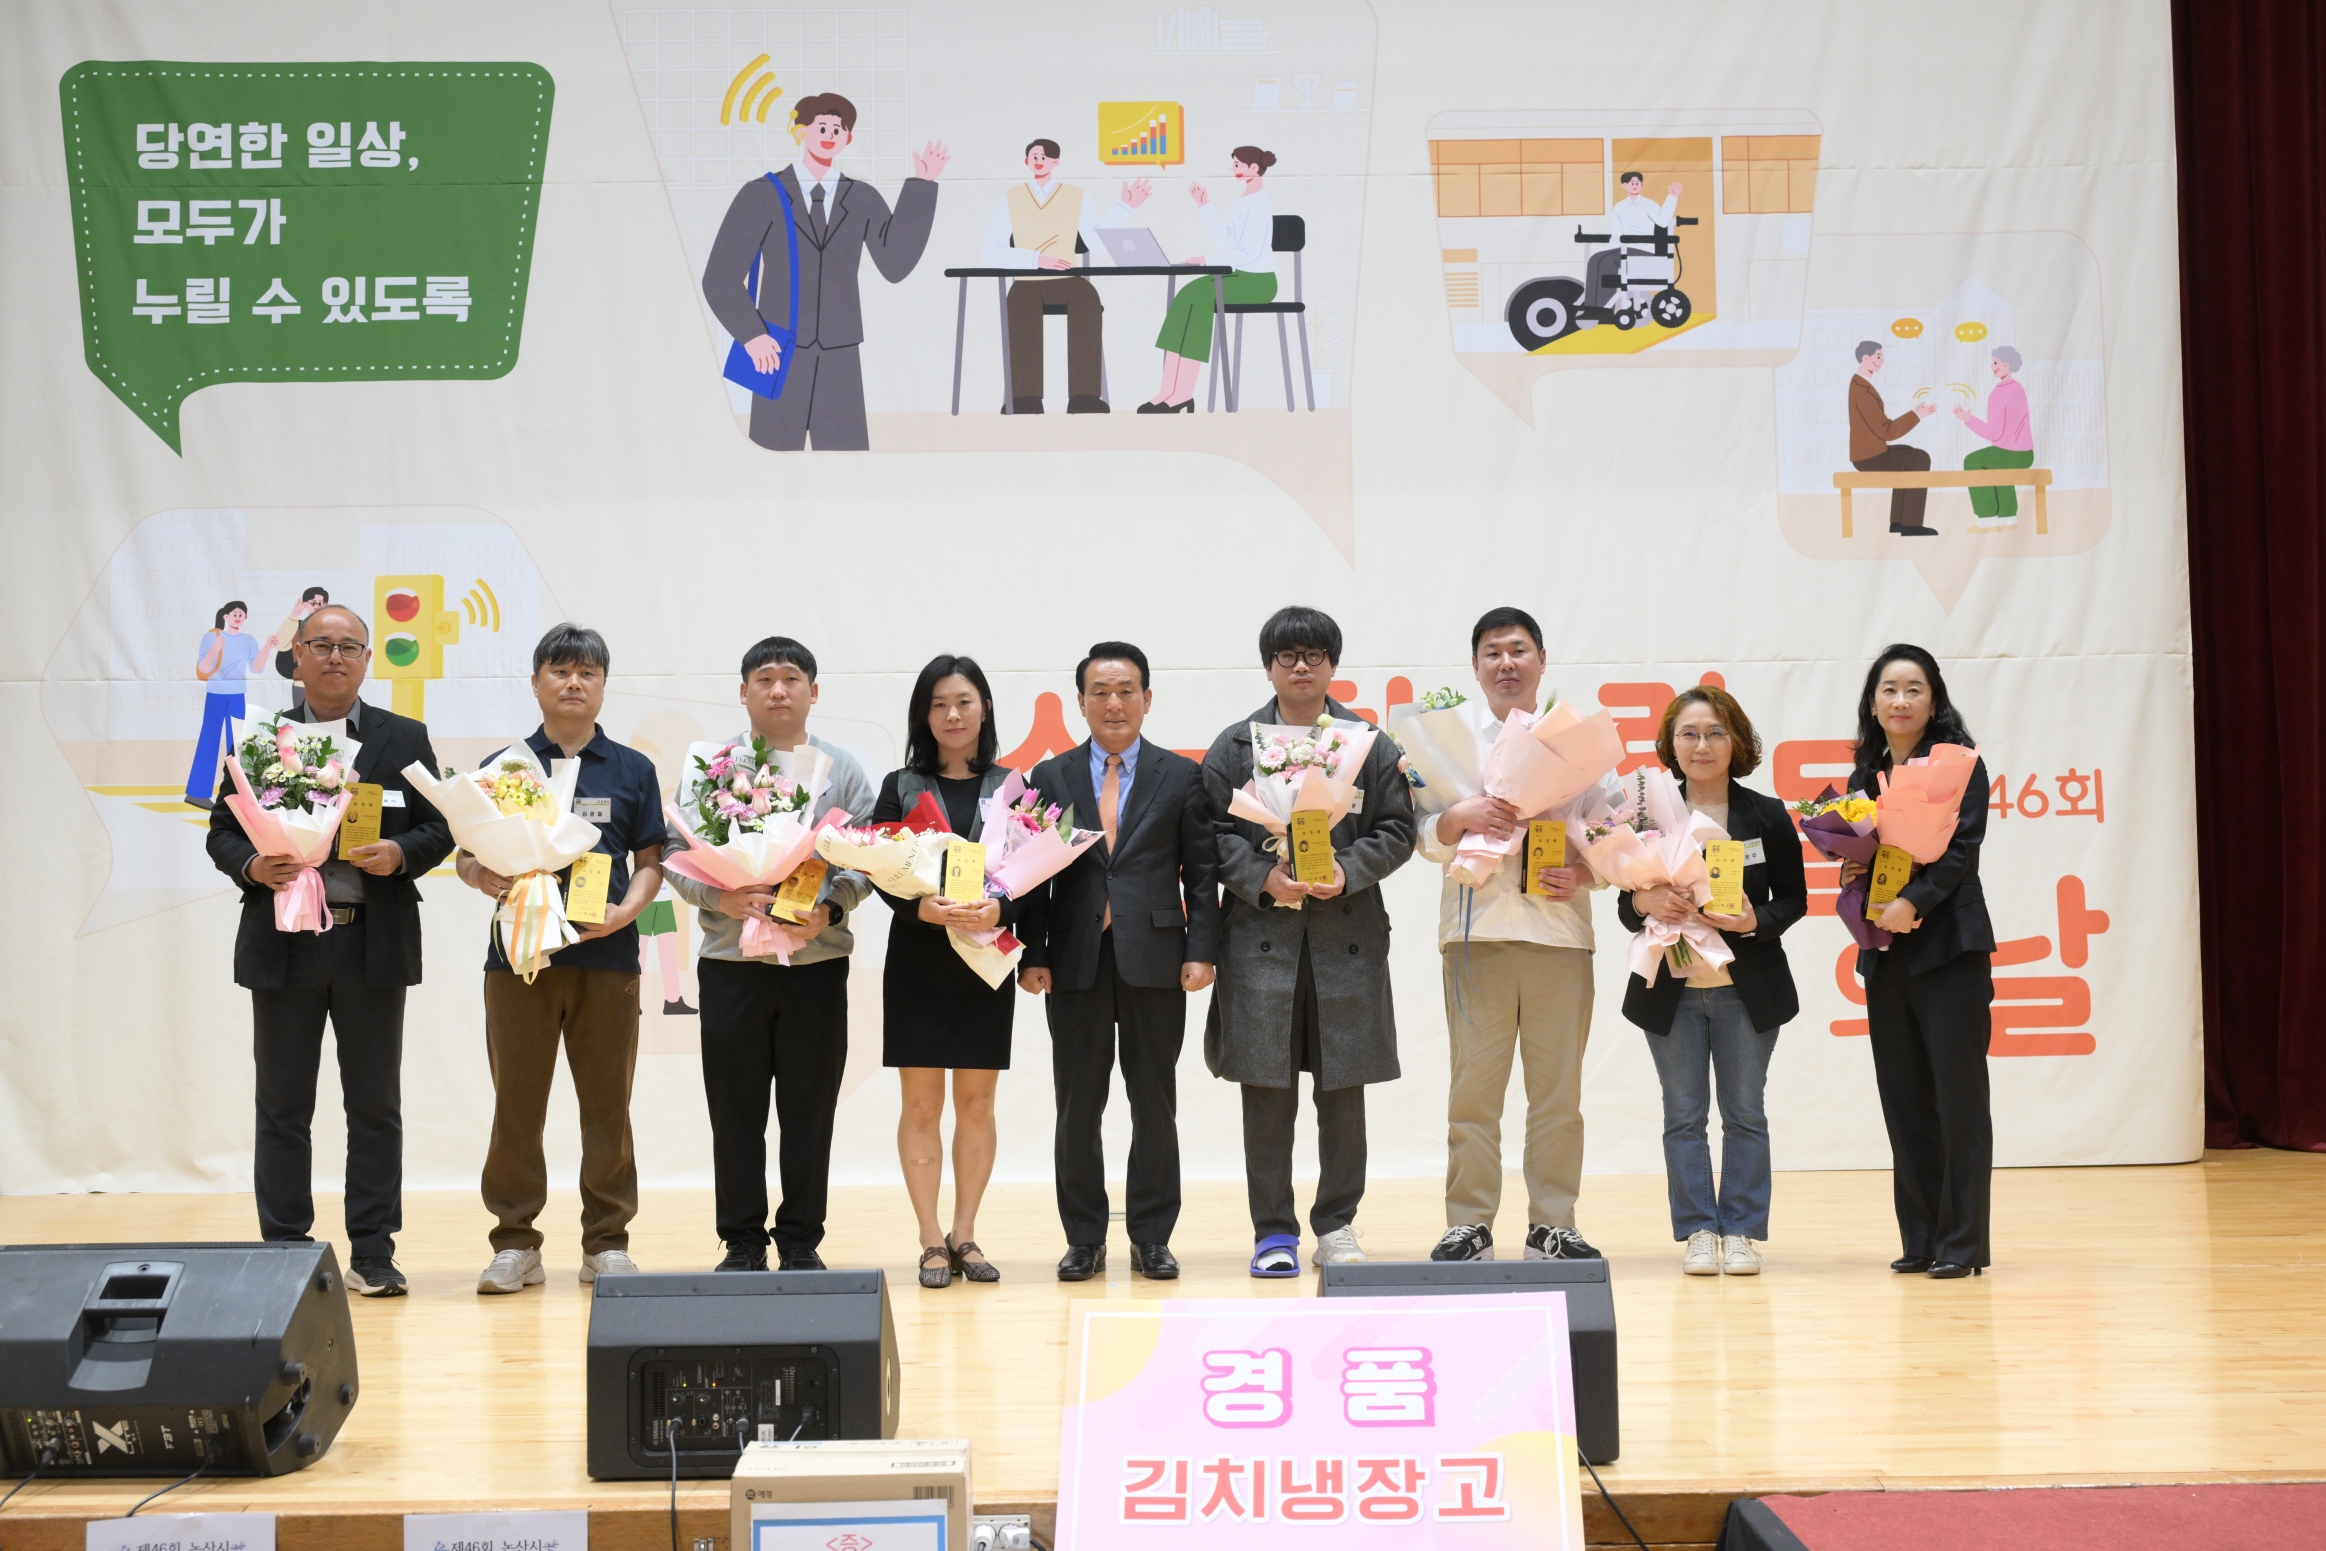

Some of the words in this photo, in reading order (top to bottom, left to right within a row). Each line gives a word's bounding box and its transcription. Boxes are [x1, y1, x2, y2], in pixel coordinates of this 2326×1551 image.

[135, 122, 288, 170] 당연한
[306, 121, 420, 171] 일상,
[133, 198, 287, 246] 모두가
[132, 277, 232, 325] 누릴
[251, 277, 302, 325] 수
[321, 275, 473, 323] 있도록
[161, 1425, 175, 1450] FBT
[1120, 1455, 1508, 1523] 김치냉장고
